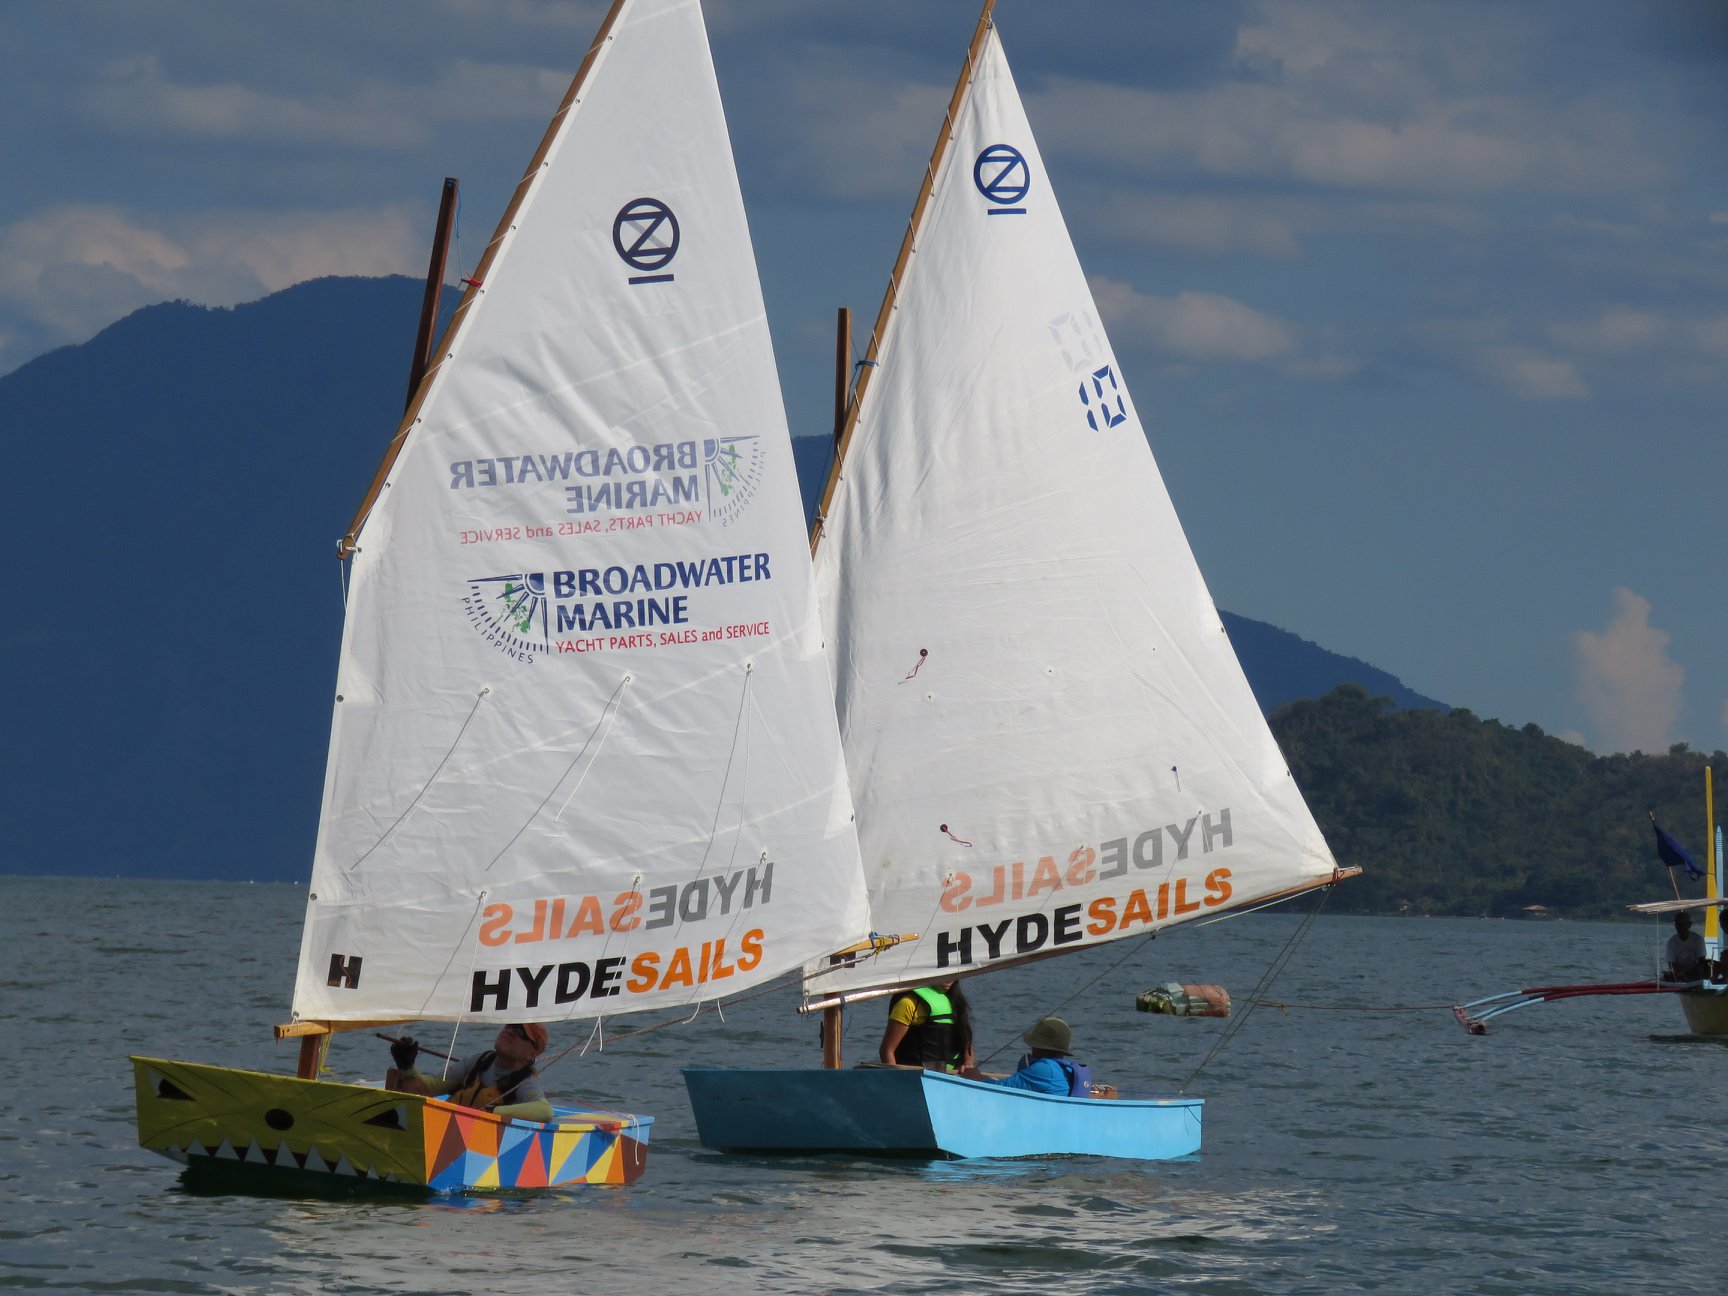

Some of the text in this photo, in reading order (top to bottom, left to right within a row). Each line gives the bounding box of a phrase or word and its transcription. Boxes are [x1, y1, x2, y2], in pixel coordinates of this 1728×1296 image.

[1079, 364, 1127, 432] 10
[552, 552, 772, 600] BROADWATER
[461, 596, 535, 665] PHILIPPINES
[555, 621, 770, 654] YACHT PARTS, SALES and SERVICE
[556, 595, 690, 634] MARINE
